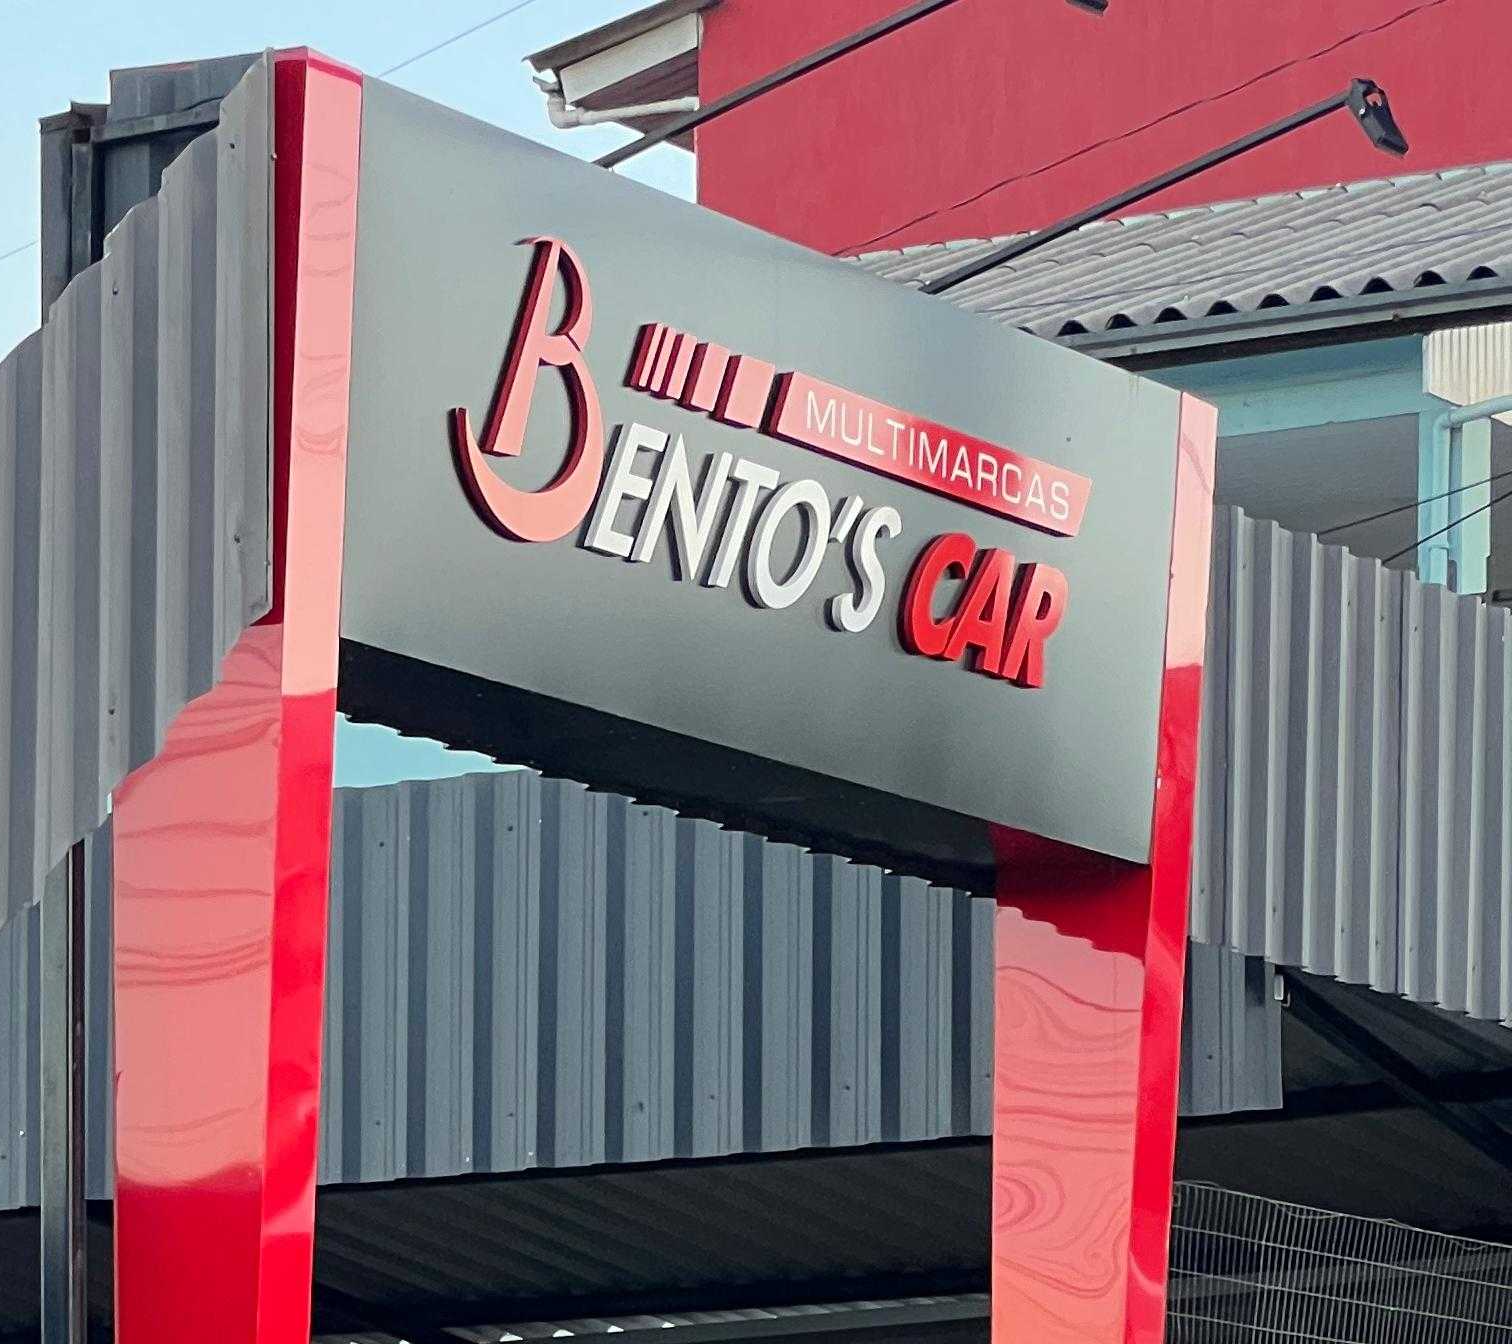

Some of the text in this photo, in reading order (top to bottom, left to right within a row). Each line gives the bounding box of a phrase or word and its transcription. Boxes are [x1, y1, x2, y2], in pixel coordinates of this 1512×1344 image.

[449, 236, 1069, 688] BENTO'S CAR
[806, 391, 1070, 521] MULTIMARCAS
